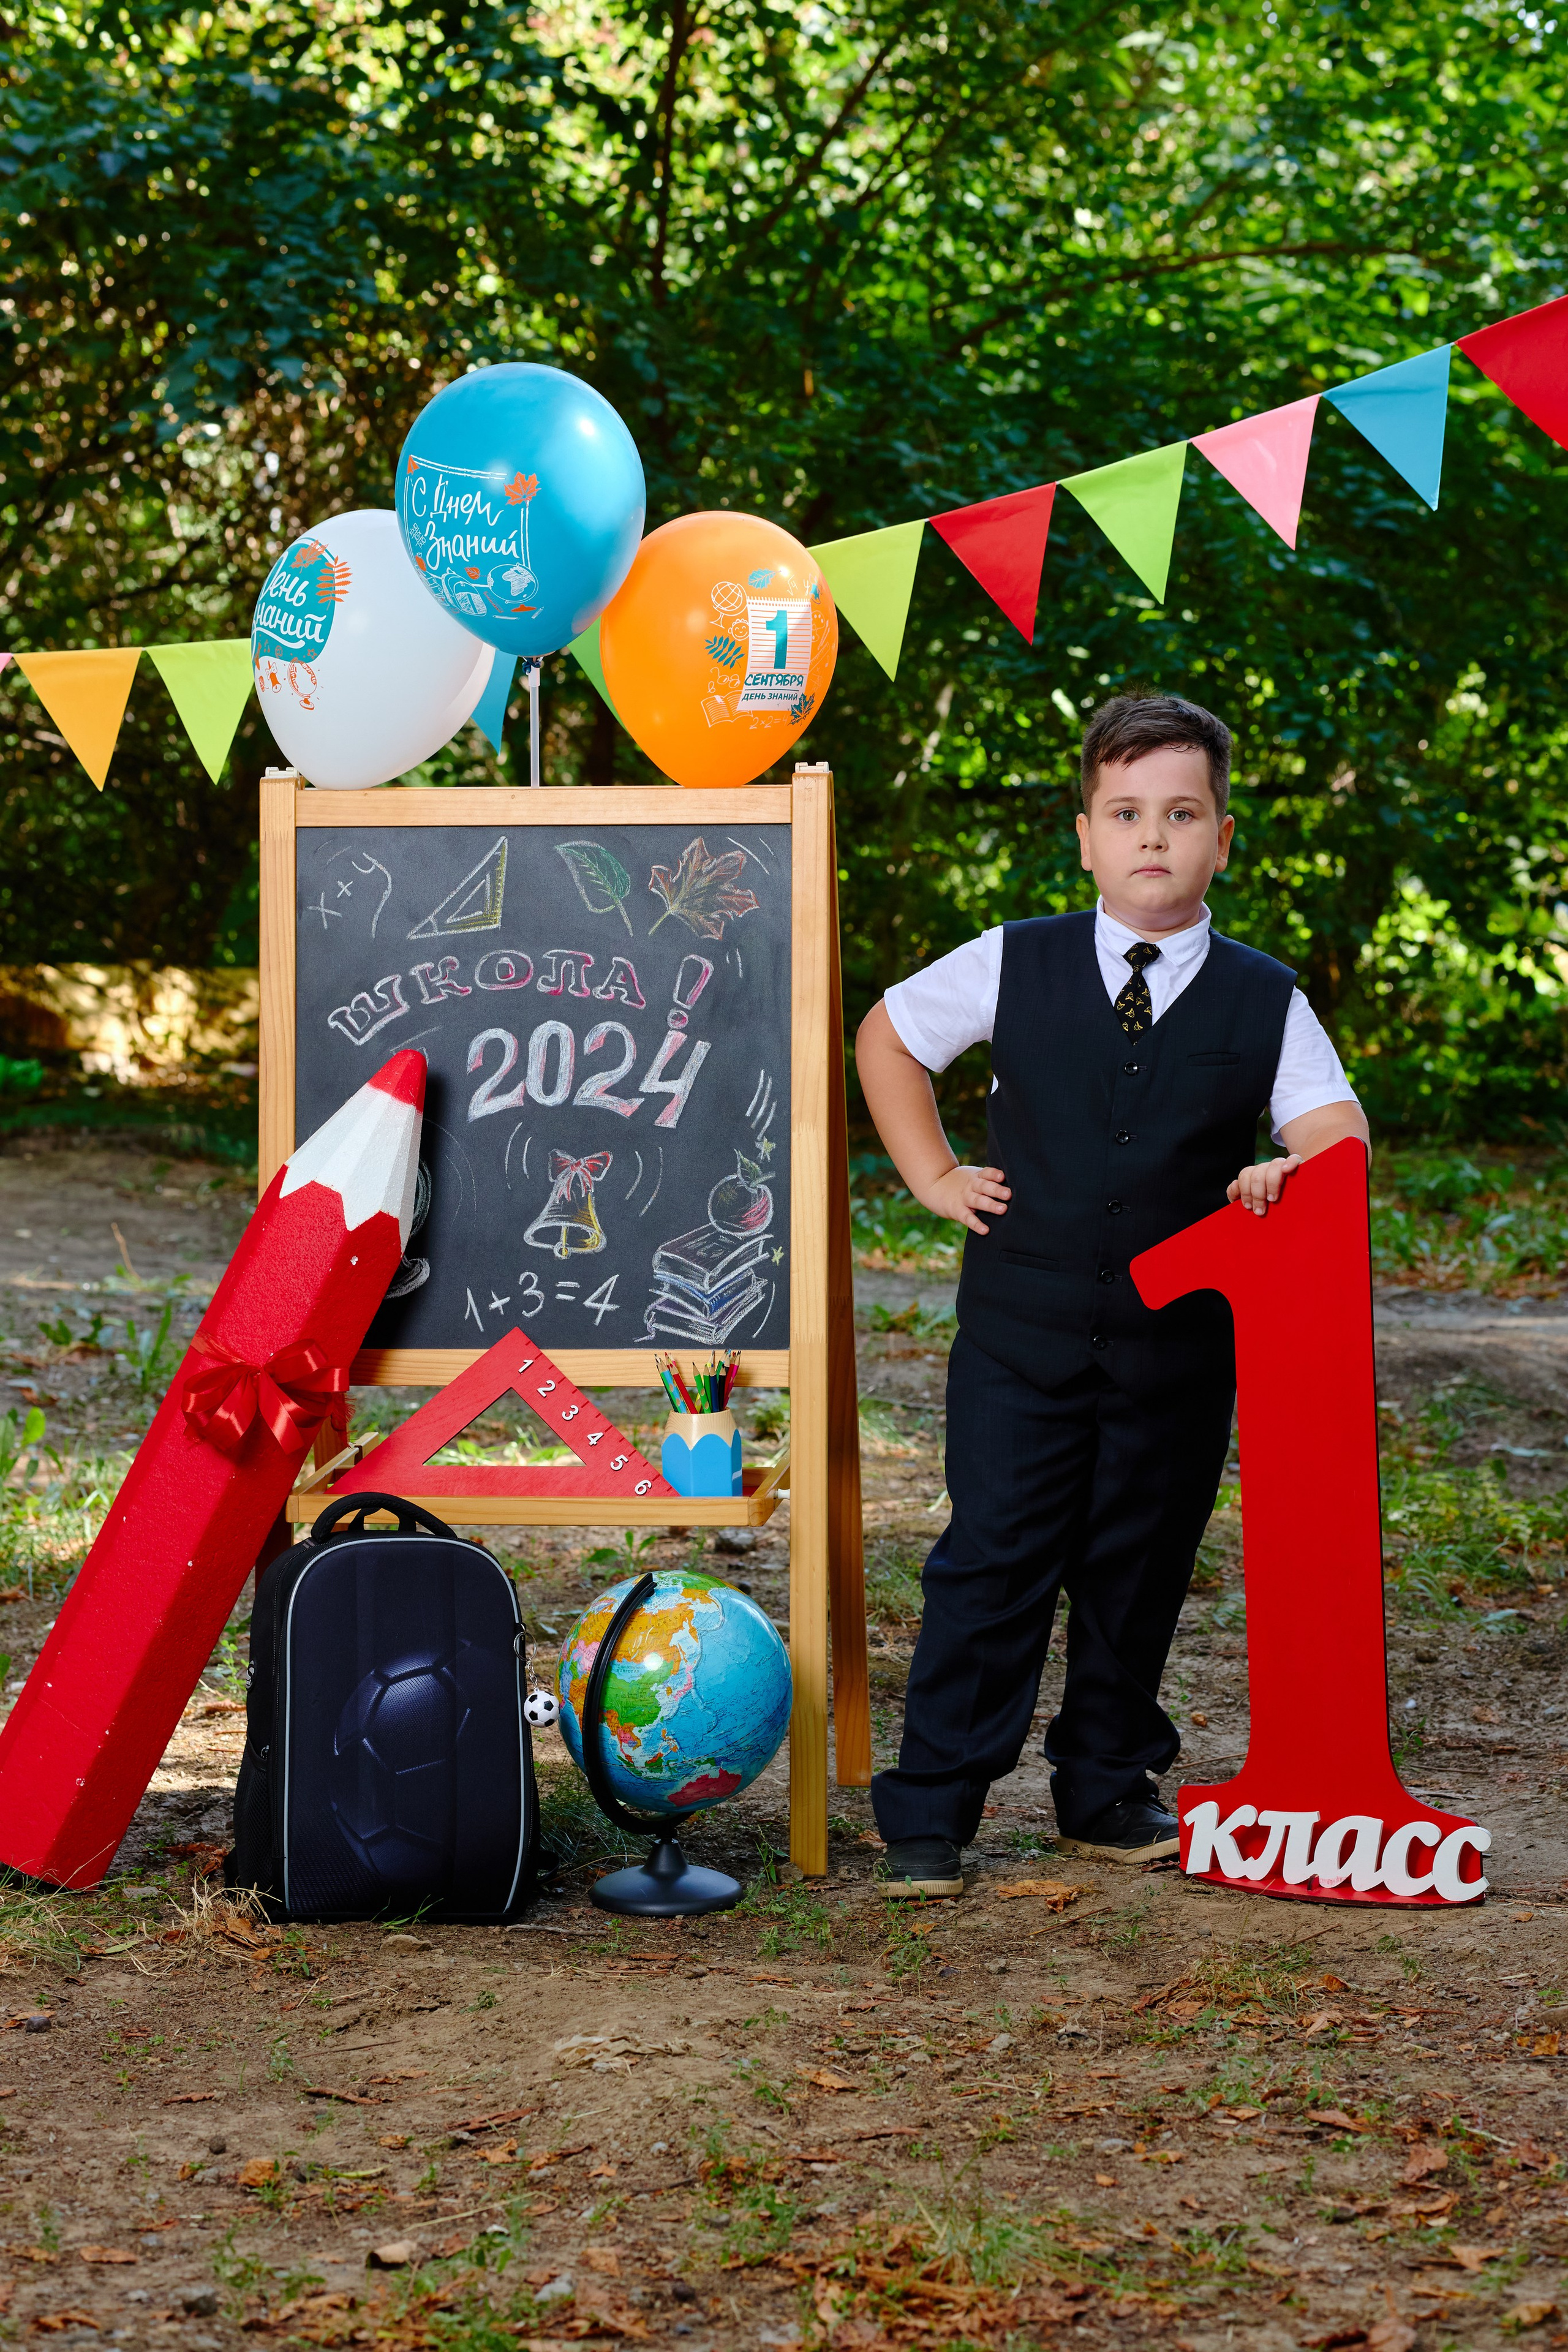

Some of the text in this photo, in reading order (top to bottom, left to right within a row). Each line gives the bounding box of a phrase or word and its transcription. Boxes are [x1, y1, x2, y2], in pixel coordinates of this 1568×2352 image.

[412, 473, 504, 527] С Днем
[424, 521, 521, 571] Знаний
[766, 609, 788, 669] 1
[741, 692, 798, 702] ДЕНЬ ЗНАНИЙ
[744, 673, 804, 687] СЕНТЯБРЯ
[467, 1019, 712, 1129] 2024
[518, 1359, 652, 1496] 1 2 3 4 5 6
[1183, 1801, 1493, 1902] класс
